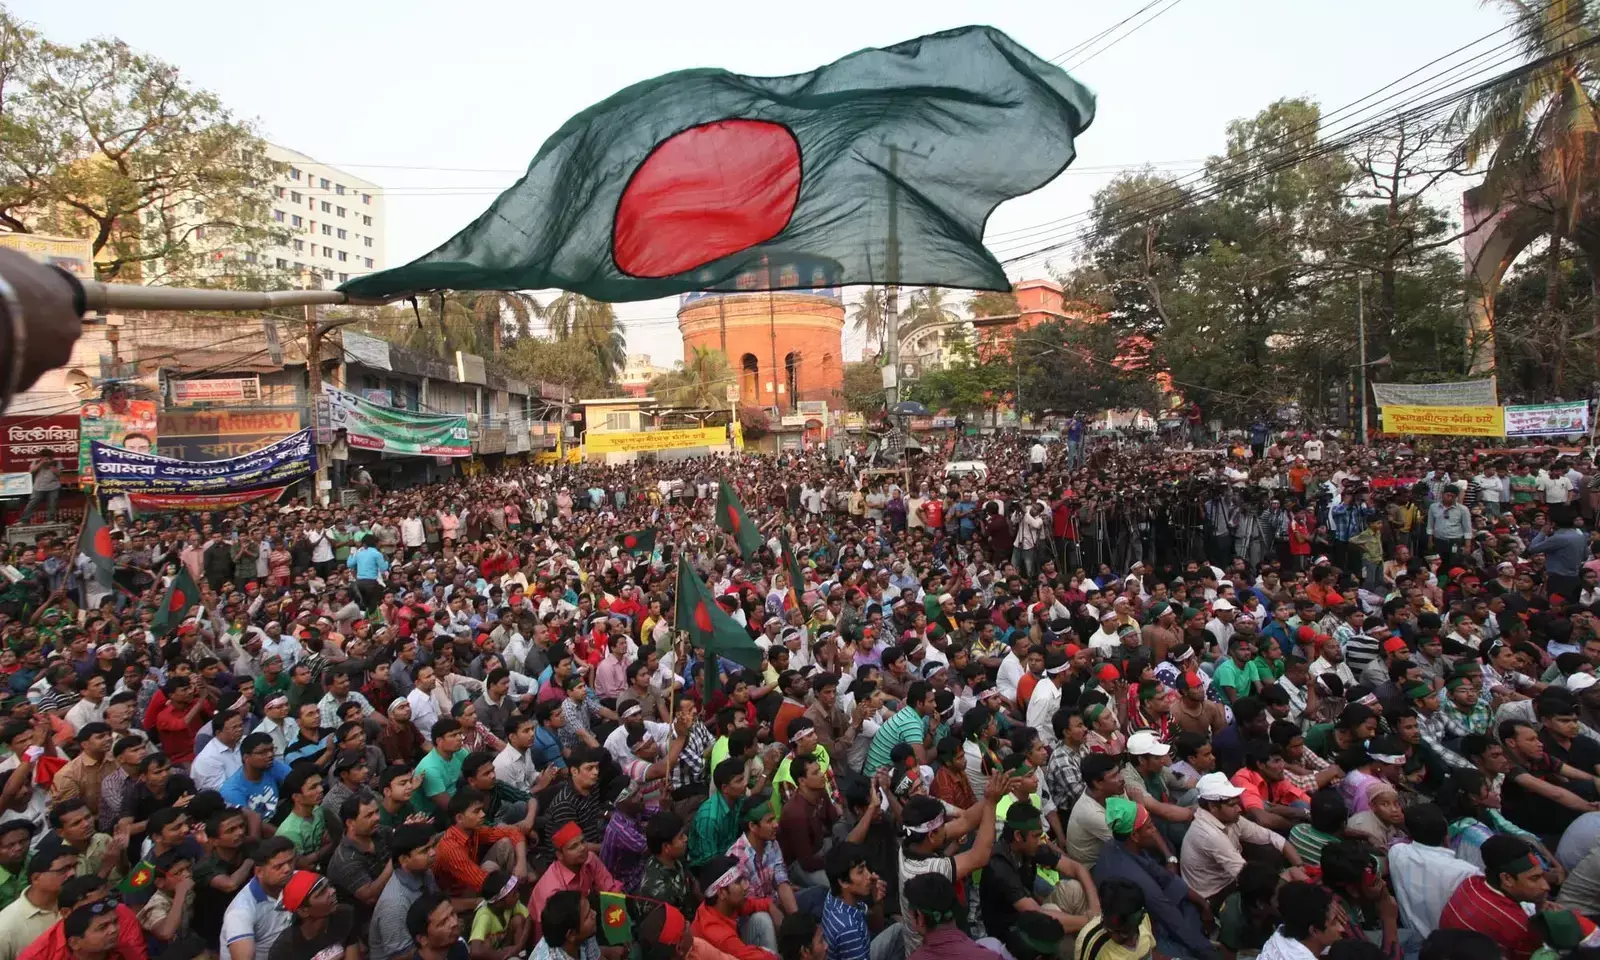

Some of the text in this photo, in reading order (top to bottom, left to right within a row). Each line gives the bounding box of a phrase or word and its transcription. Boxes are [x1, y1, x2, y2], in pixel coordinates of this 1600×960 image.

[184, 412, 294, 432] PHARMACY
[1391, 413, 1493, 424] যুদ্ধাপরাধীদের ফাঁসি চাই
[8, 426, 79, 441] ভিক্টোরিয়া
[96, 462, 157, 475] আমরা
